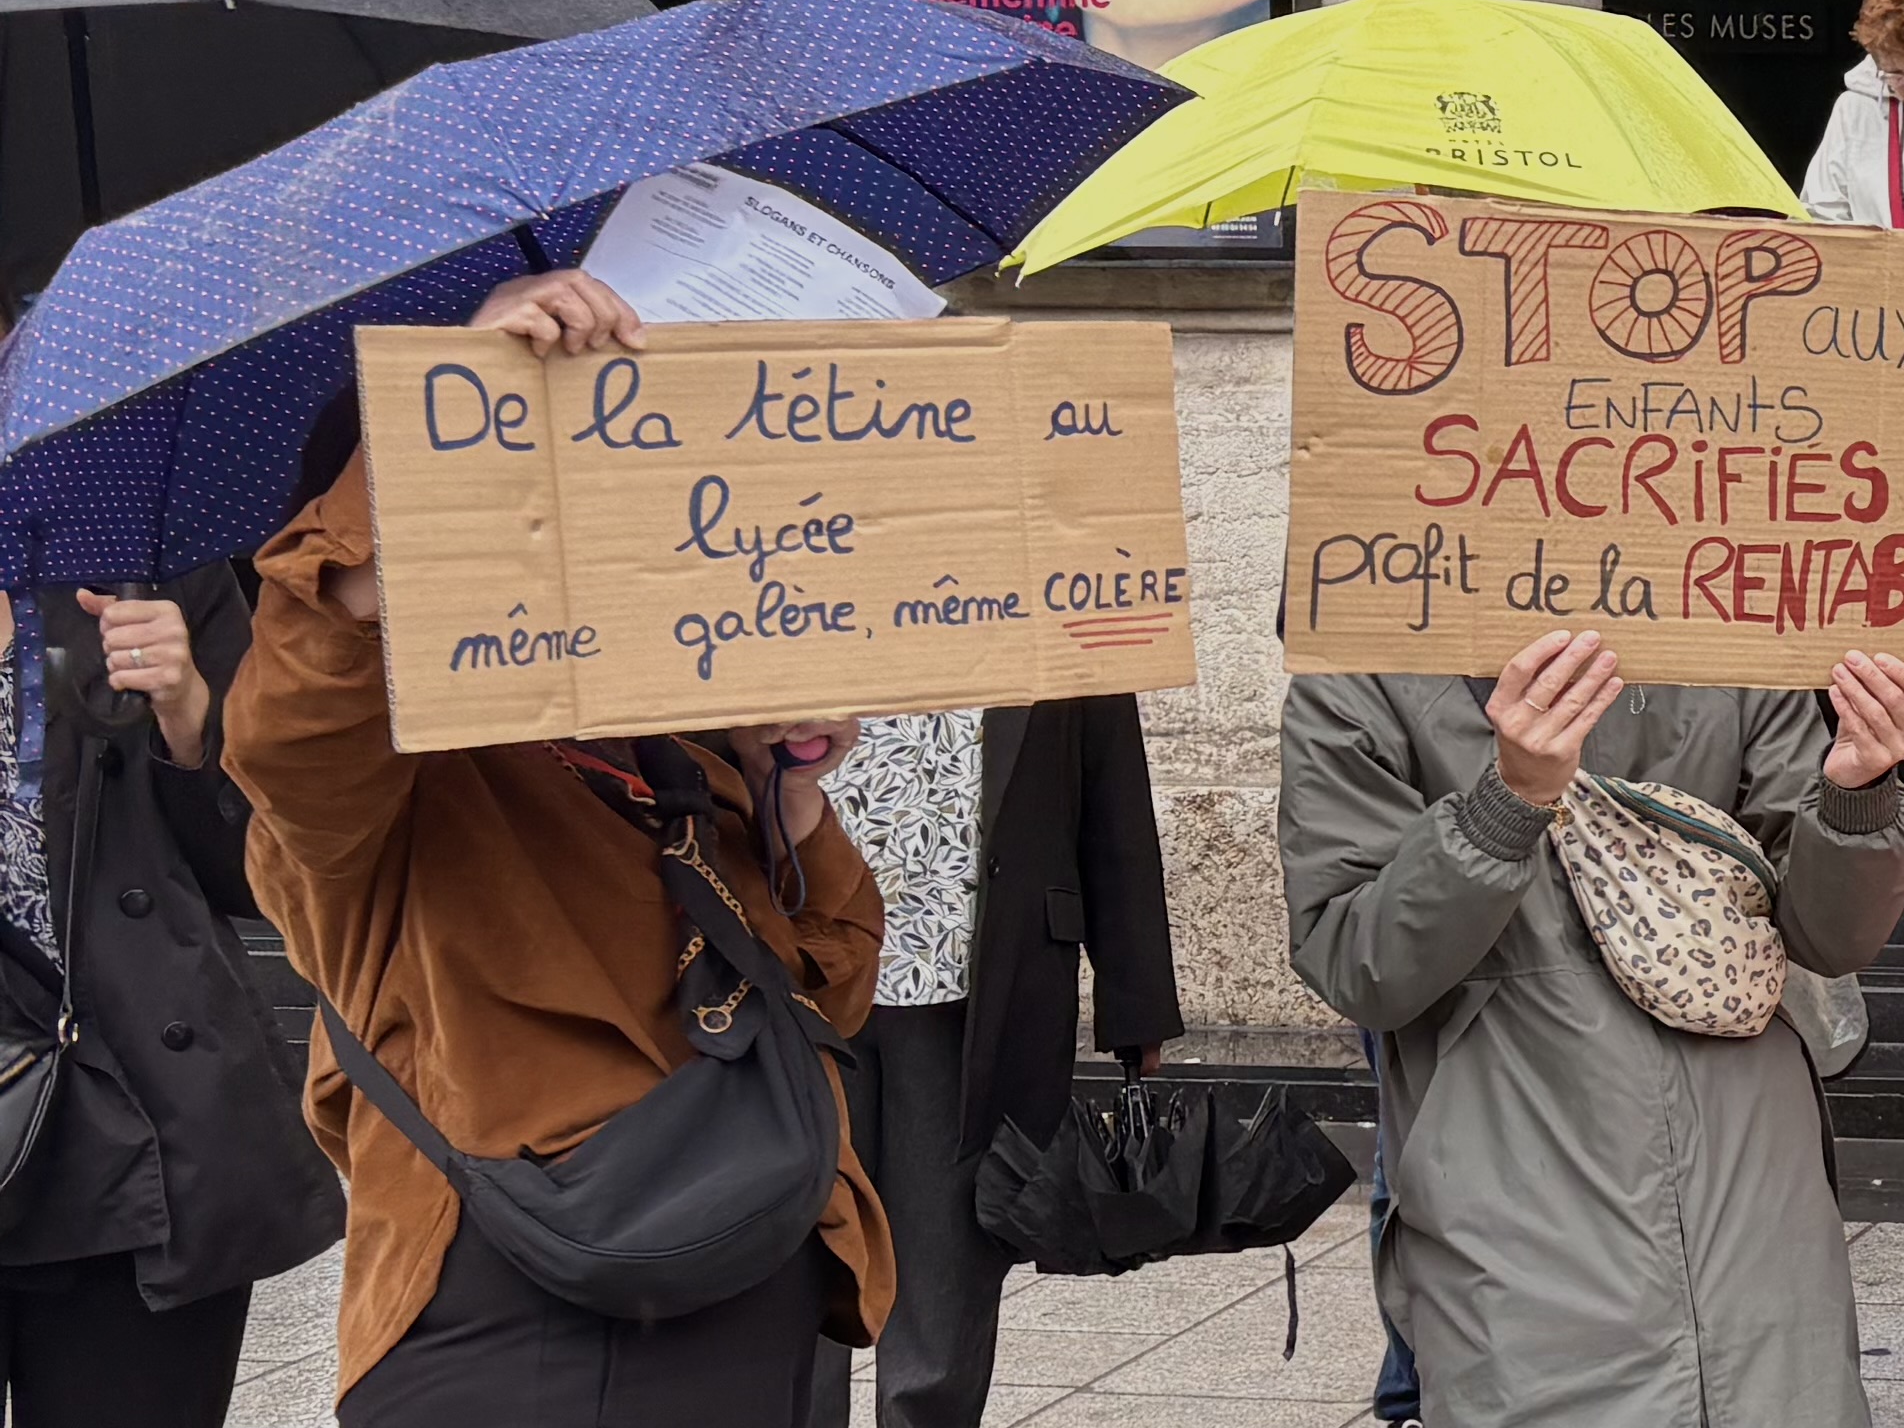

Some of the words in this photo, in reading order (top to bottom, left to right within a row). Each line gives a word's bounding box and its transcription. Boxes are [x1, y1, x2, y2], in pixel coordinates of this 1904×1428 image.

[1709, 13, 1814, 41] MUSES
[807, 232, 828, 247] ET
[1325, 200, 1823, 397] STOP
[424, 363, 536, 452] De
[572, 357, 682, 449] la
[724, 359, 977, 443] tétine
[1043, 399, 1123, 441] au
[674, 474, 856, 579] lycée
[1309, 521, 1480, 632] profit
[1505, 538, 1570, 616] de
[1589, 544, 1659, 620] la
[449, 601, 602, 671] même
[673, 580, 876, 680] galère,
[893, 576, 1031, 629] même
[1044, 548, 1188, 613] COLÈRE
